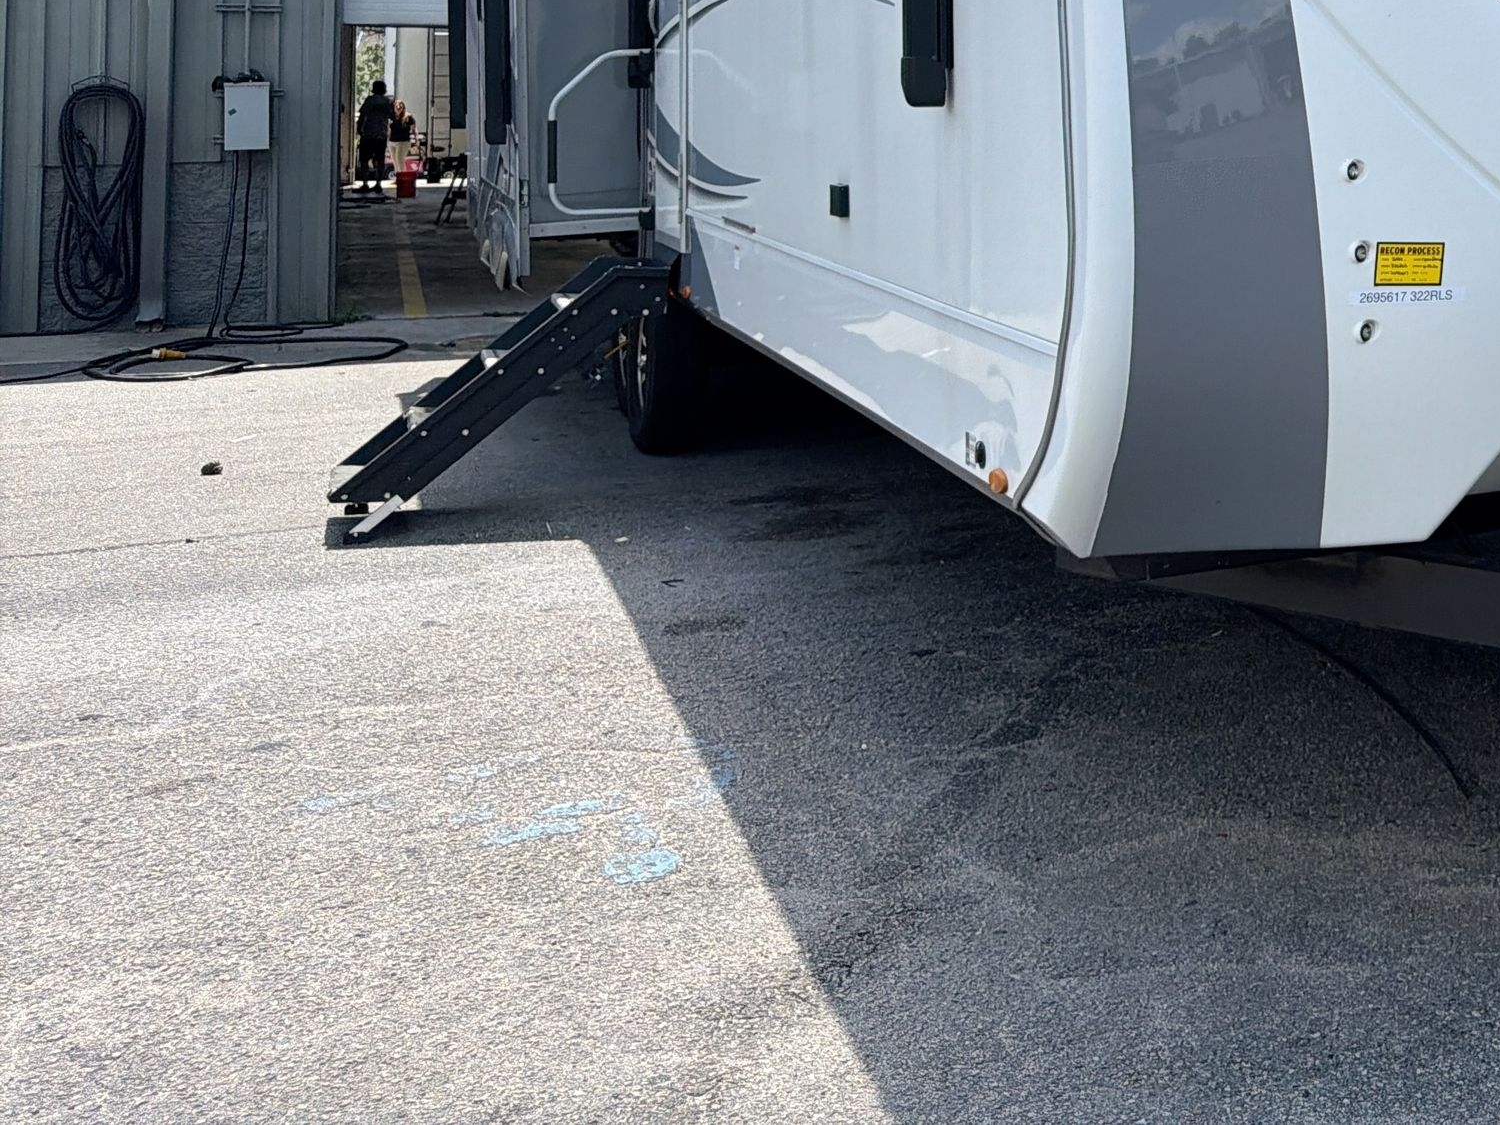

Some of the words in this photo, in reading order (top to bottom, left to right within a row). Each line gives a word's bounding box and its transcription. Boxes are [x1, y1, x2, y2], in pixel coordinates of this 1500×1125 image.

[1380, 246, 1405, 255] RECON
[1407, 246, 1440, 255] PROCESS
[1359, 291, 1407, 304] 2695617
[1410, 289, 1453, 302] 322RLS
